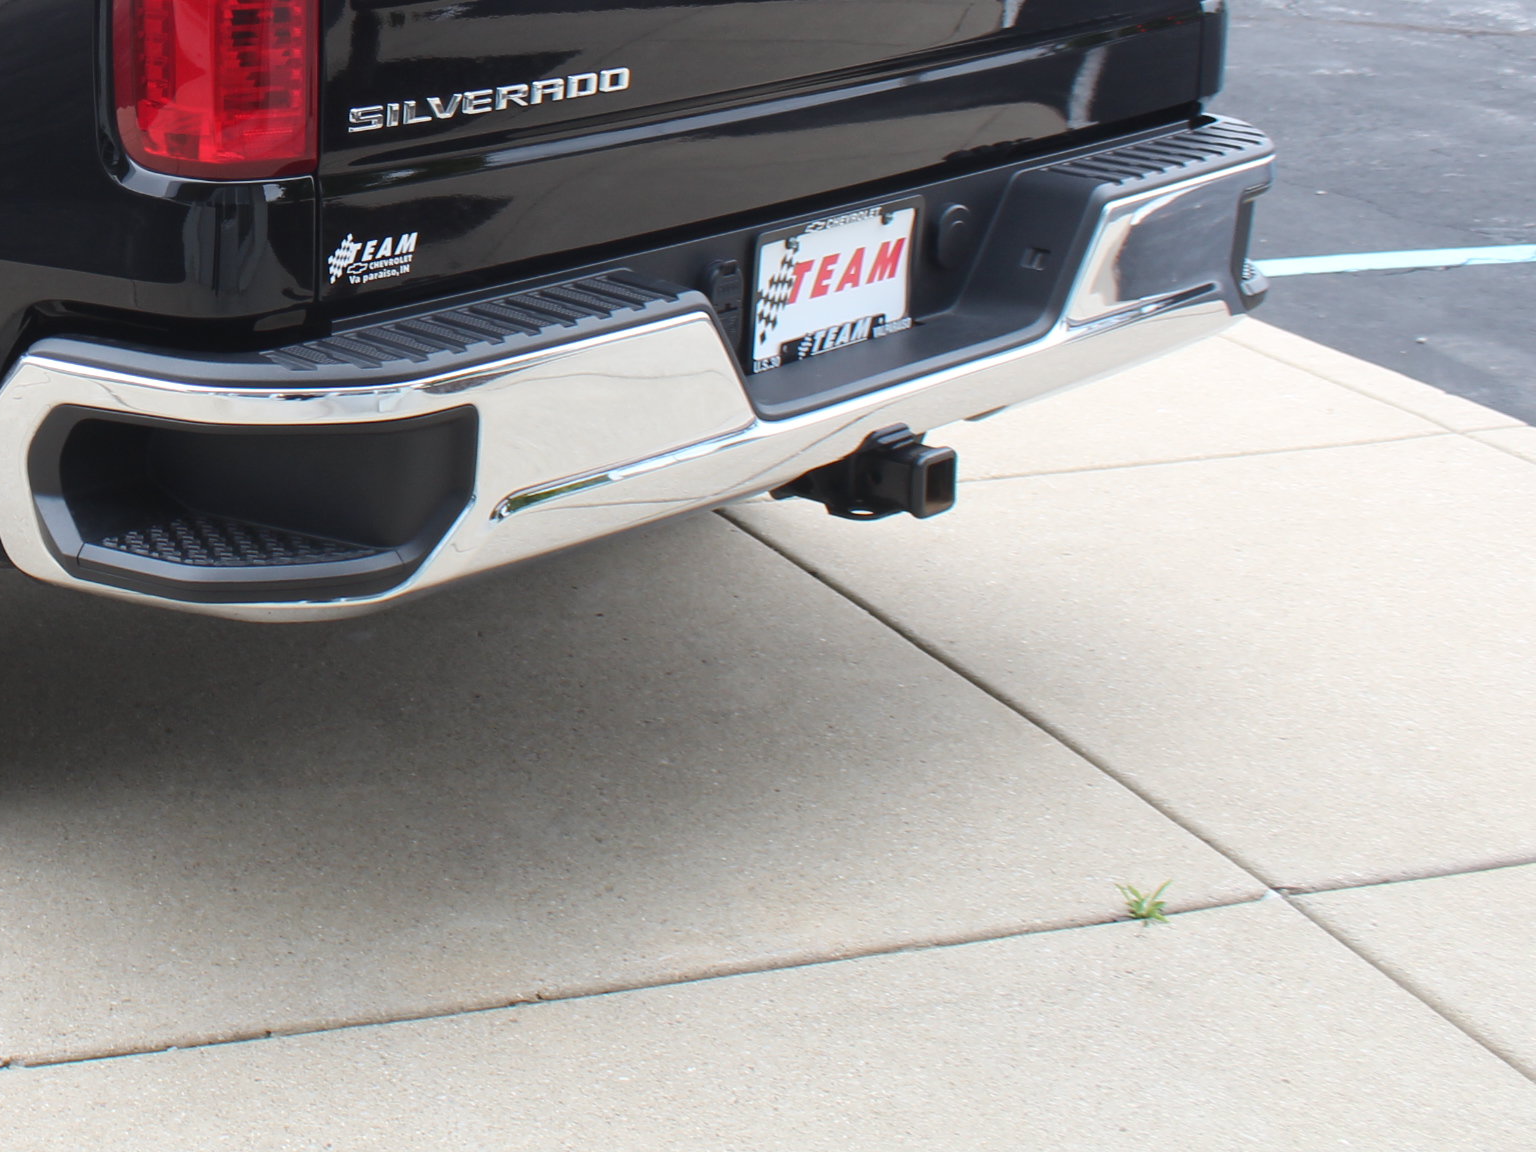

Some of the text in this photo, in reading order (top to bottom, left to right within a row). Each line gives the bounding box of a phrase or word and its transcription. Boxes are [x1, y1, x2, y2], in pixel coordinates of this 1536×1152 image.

[348, 67, 630, 132] SILVERADO
[346, 232, 418, 263] TEAM
[369, 254, 413, 270] CHEVROLET
[349, 264, 410, 284] Vaparaiso, IN
[786, 237, 907, 305] TEAM
[811, 316, 873, 354] TEAM
